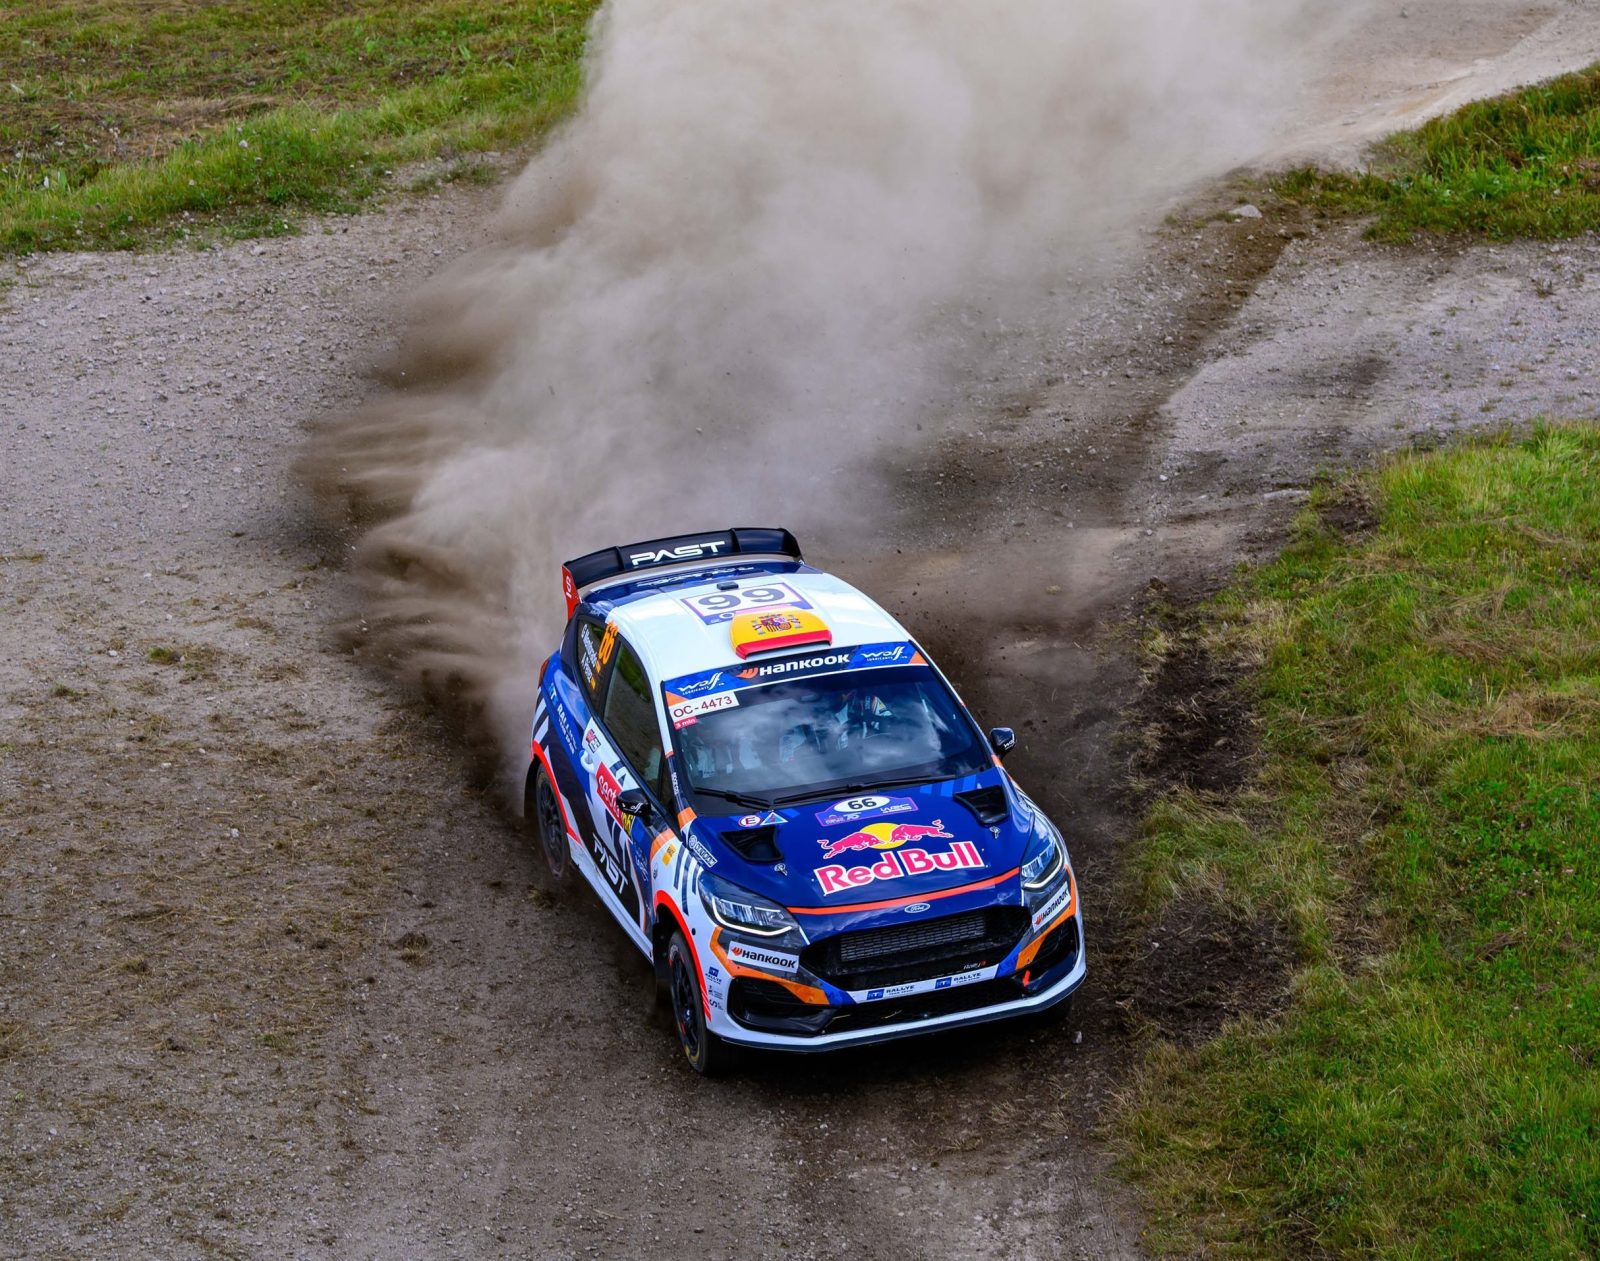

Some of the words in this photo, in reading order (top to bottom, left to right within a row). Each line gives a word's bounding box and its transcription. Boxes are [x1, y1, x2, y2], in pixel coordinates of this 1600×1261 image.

[630, 541, 725, 565] PAST
[848, 797, 877, 810] 66
[592, 832, 628, 894] PAST
[815, 852, 902, 895] Red
[900, 842, 984, 875] Bull
[741, 949, 798, 968] Hankook
[953, 973, 981, 982] RALLYE
[886, 985, 915, 993] RALLYE
